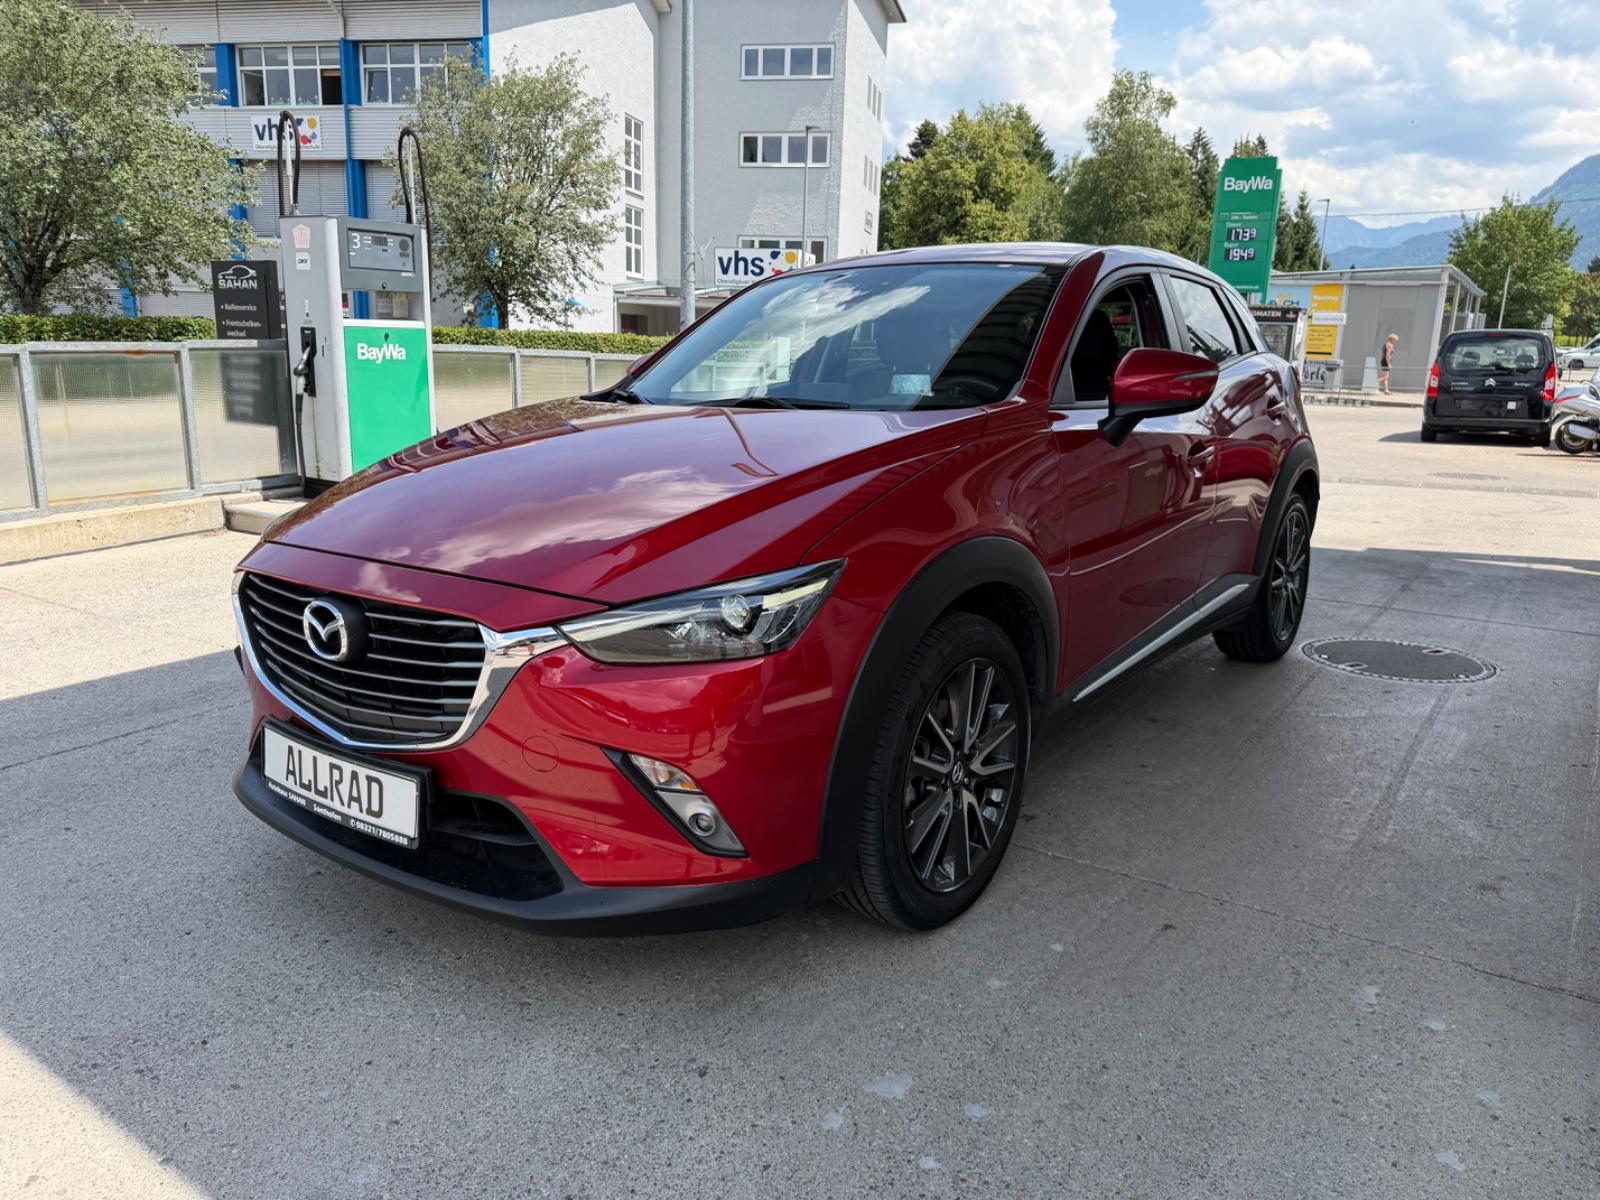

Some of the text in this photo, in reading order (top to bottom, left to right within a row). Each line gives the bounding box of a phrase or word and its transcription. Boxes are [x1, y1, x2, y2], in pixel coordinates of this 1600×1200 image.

[1224, 176, 1273, 193] BayWa
[351, 233, 360, 249] 3
[718, 250, 764, 276] vhs
[218, 280, 258, 290] SAHAN
[225, 303, 257, 311] Reifenservice
[357, 343, 406, 364] BayWa
[286, 745, 384, 819] ALLRAD
